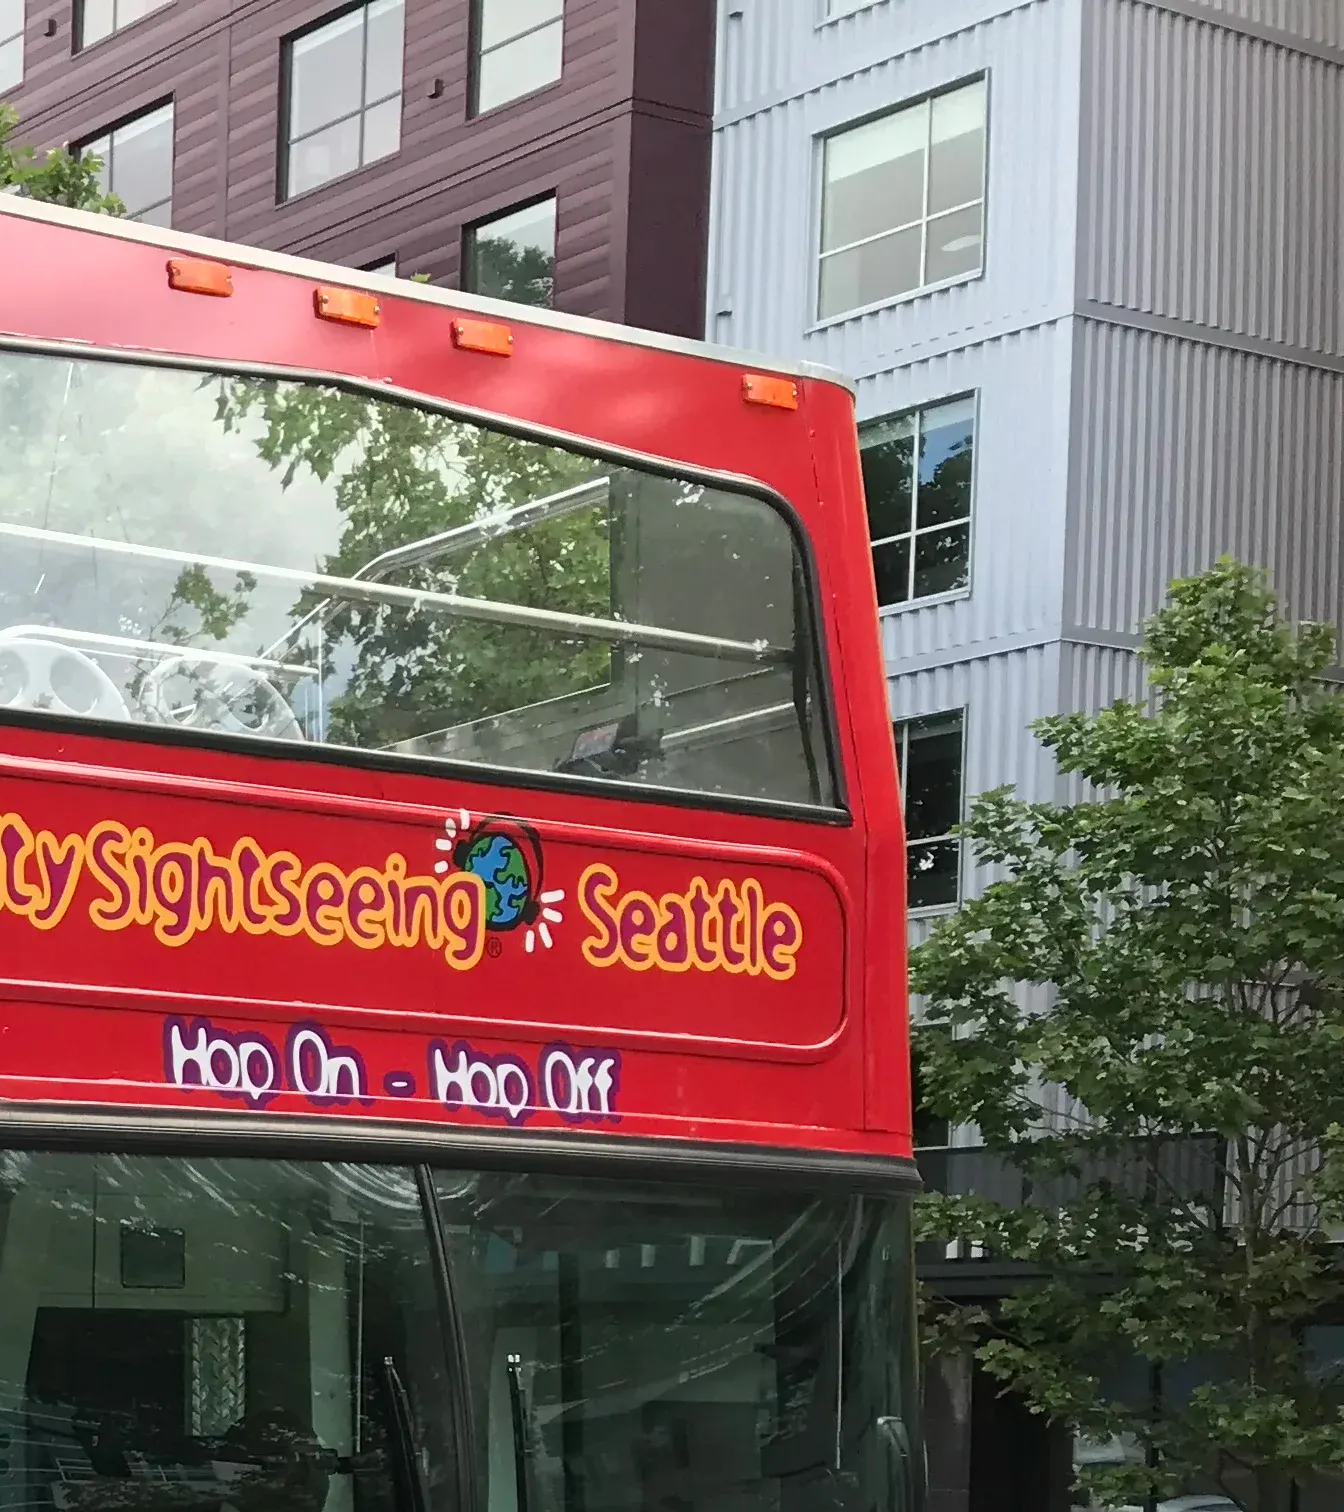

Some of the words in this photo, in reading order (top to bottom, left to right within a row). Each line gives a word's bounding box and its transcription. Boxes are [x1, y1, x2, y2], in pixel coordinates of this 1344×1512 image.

[578, 862, 802, 981] Seattle
[173, 1026, 275, 1100] Hop
[292, 1028, 360, 1097] On
[433, 1048, 530, 1118] Hop
[544, 1050, 615, 1114] Off
